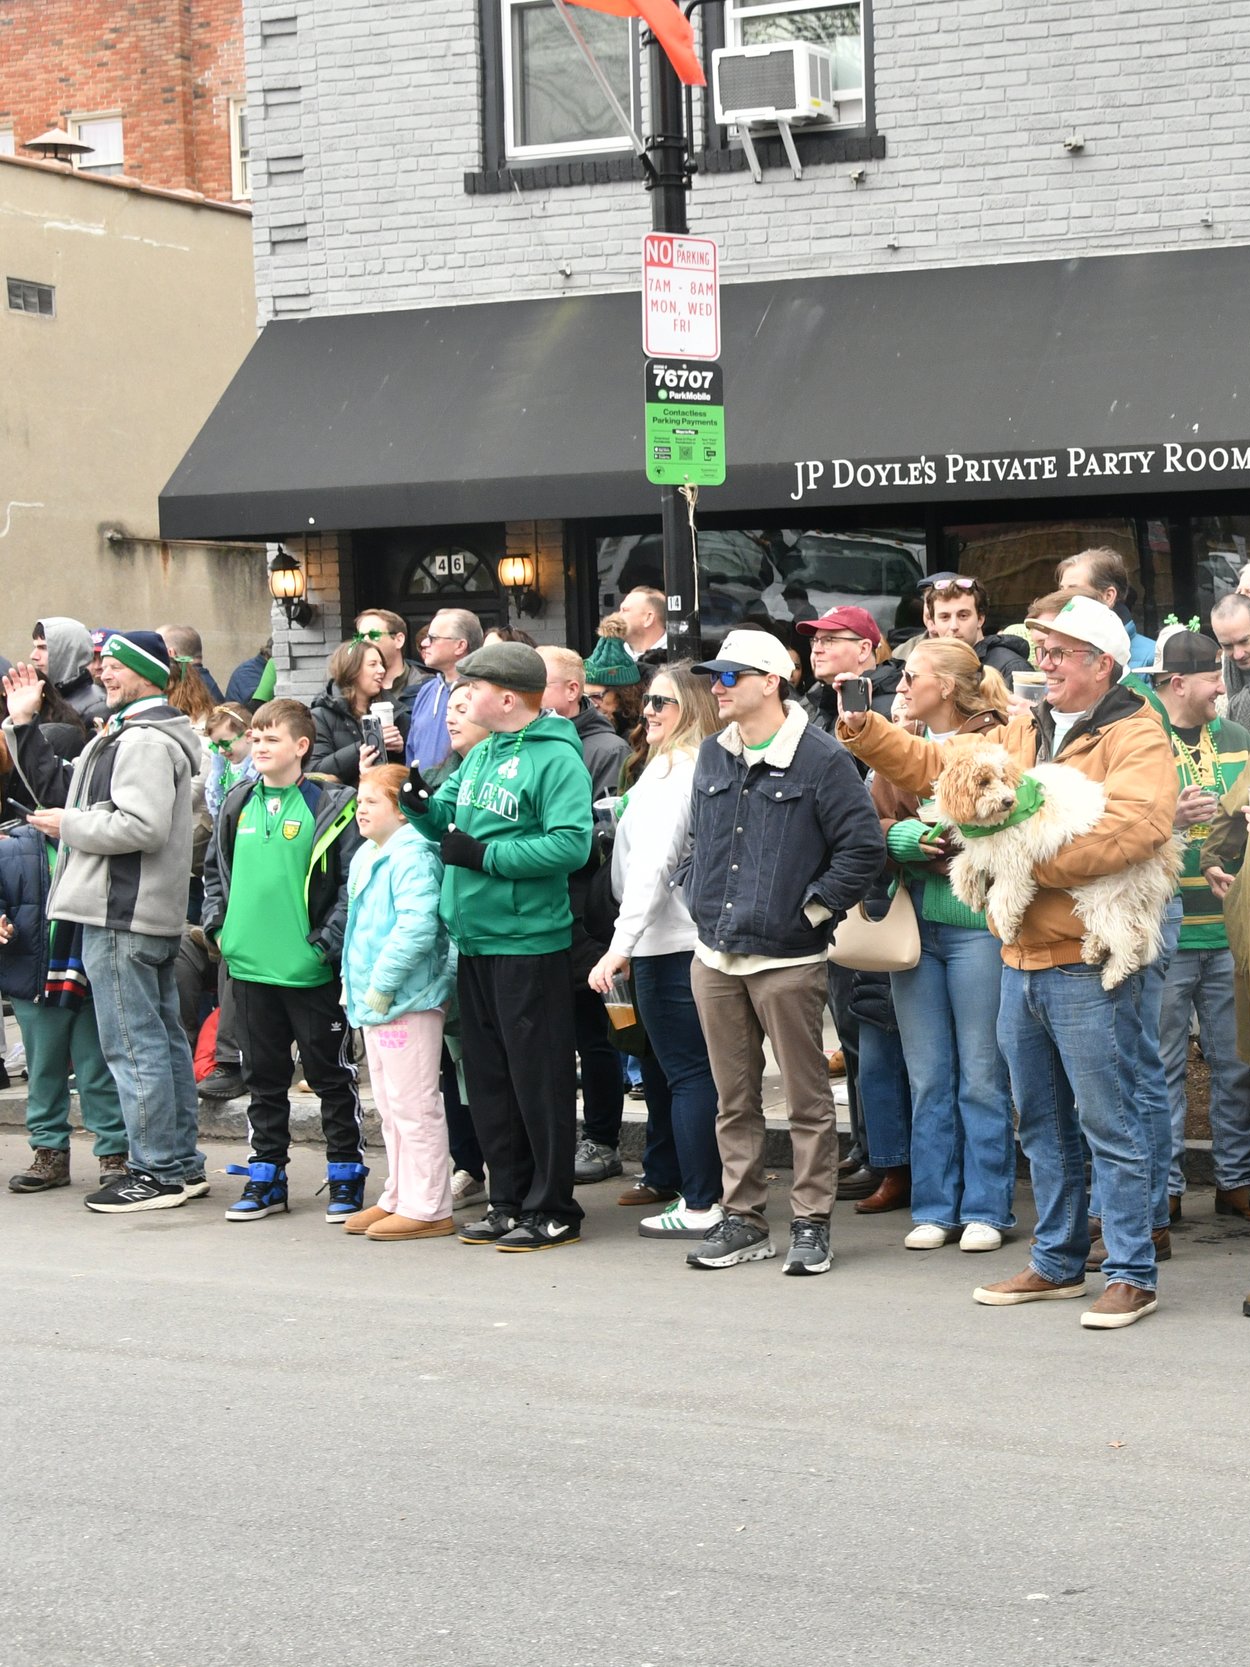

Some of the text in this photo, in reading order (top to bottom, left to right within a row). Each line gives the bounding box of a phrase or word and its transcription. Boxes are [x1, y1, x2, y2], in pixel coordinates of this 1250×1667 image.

[646, 239, 710, 266] NO PARKING
[649, 278, 671, 293] 7AM
[690, 281, 713, 297] 8AM
[650, 299, 712, 316] MON, WED
[673, 318, 690, 333] FRI
[653, 369, 713, 388] 76707
[669, 390, 711, 401] ParkMobile
[652, 416, 717, 426] Parking Payments
[663, 408, 707, 418] Contactless
[790, 460, 824, 500] JP
[832, 455, 937, 489] DOYLE'S
[945, 453, 1058, 484] PRIVATE
[1067, 447, 1155, 477] PARTY
[438, 558, 461, 572] 46
